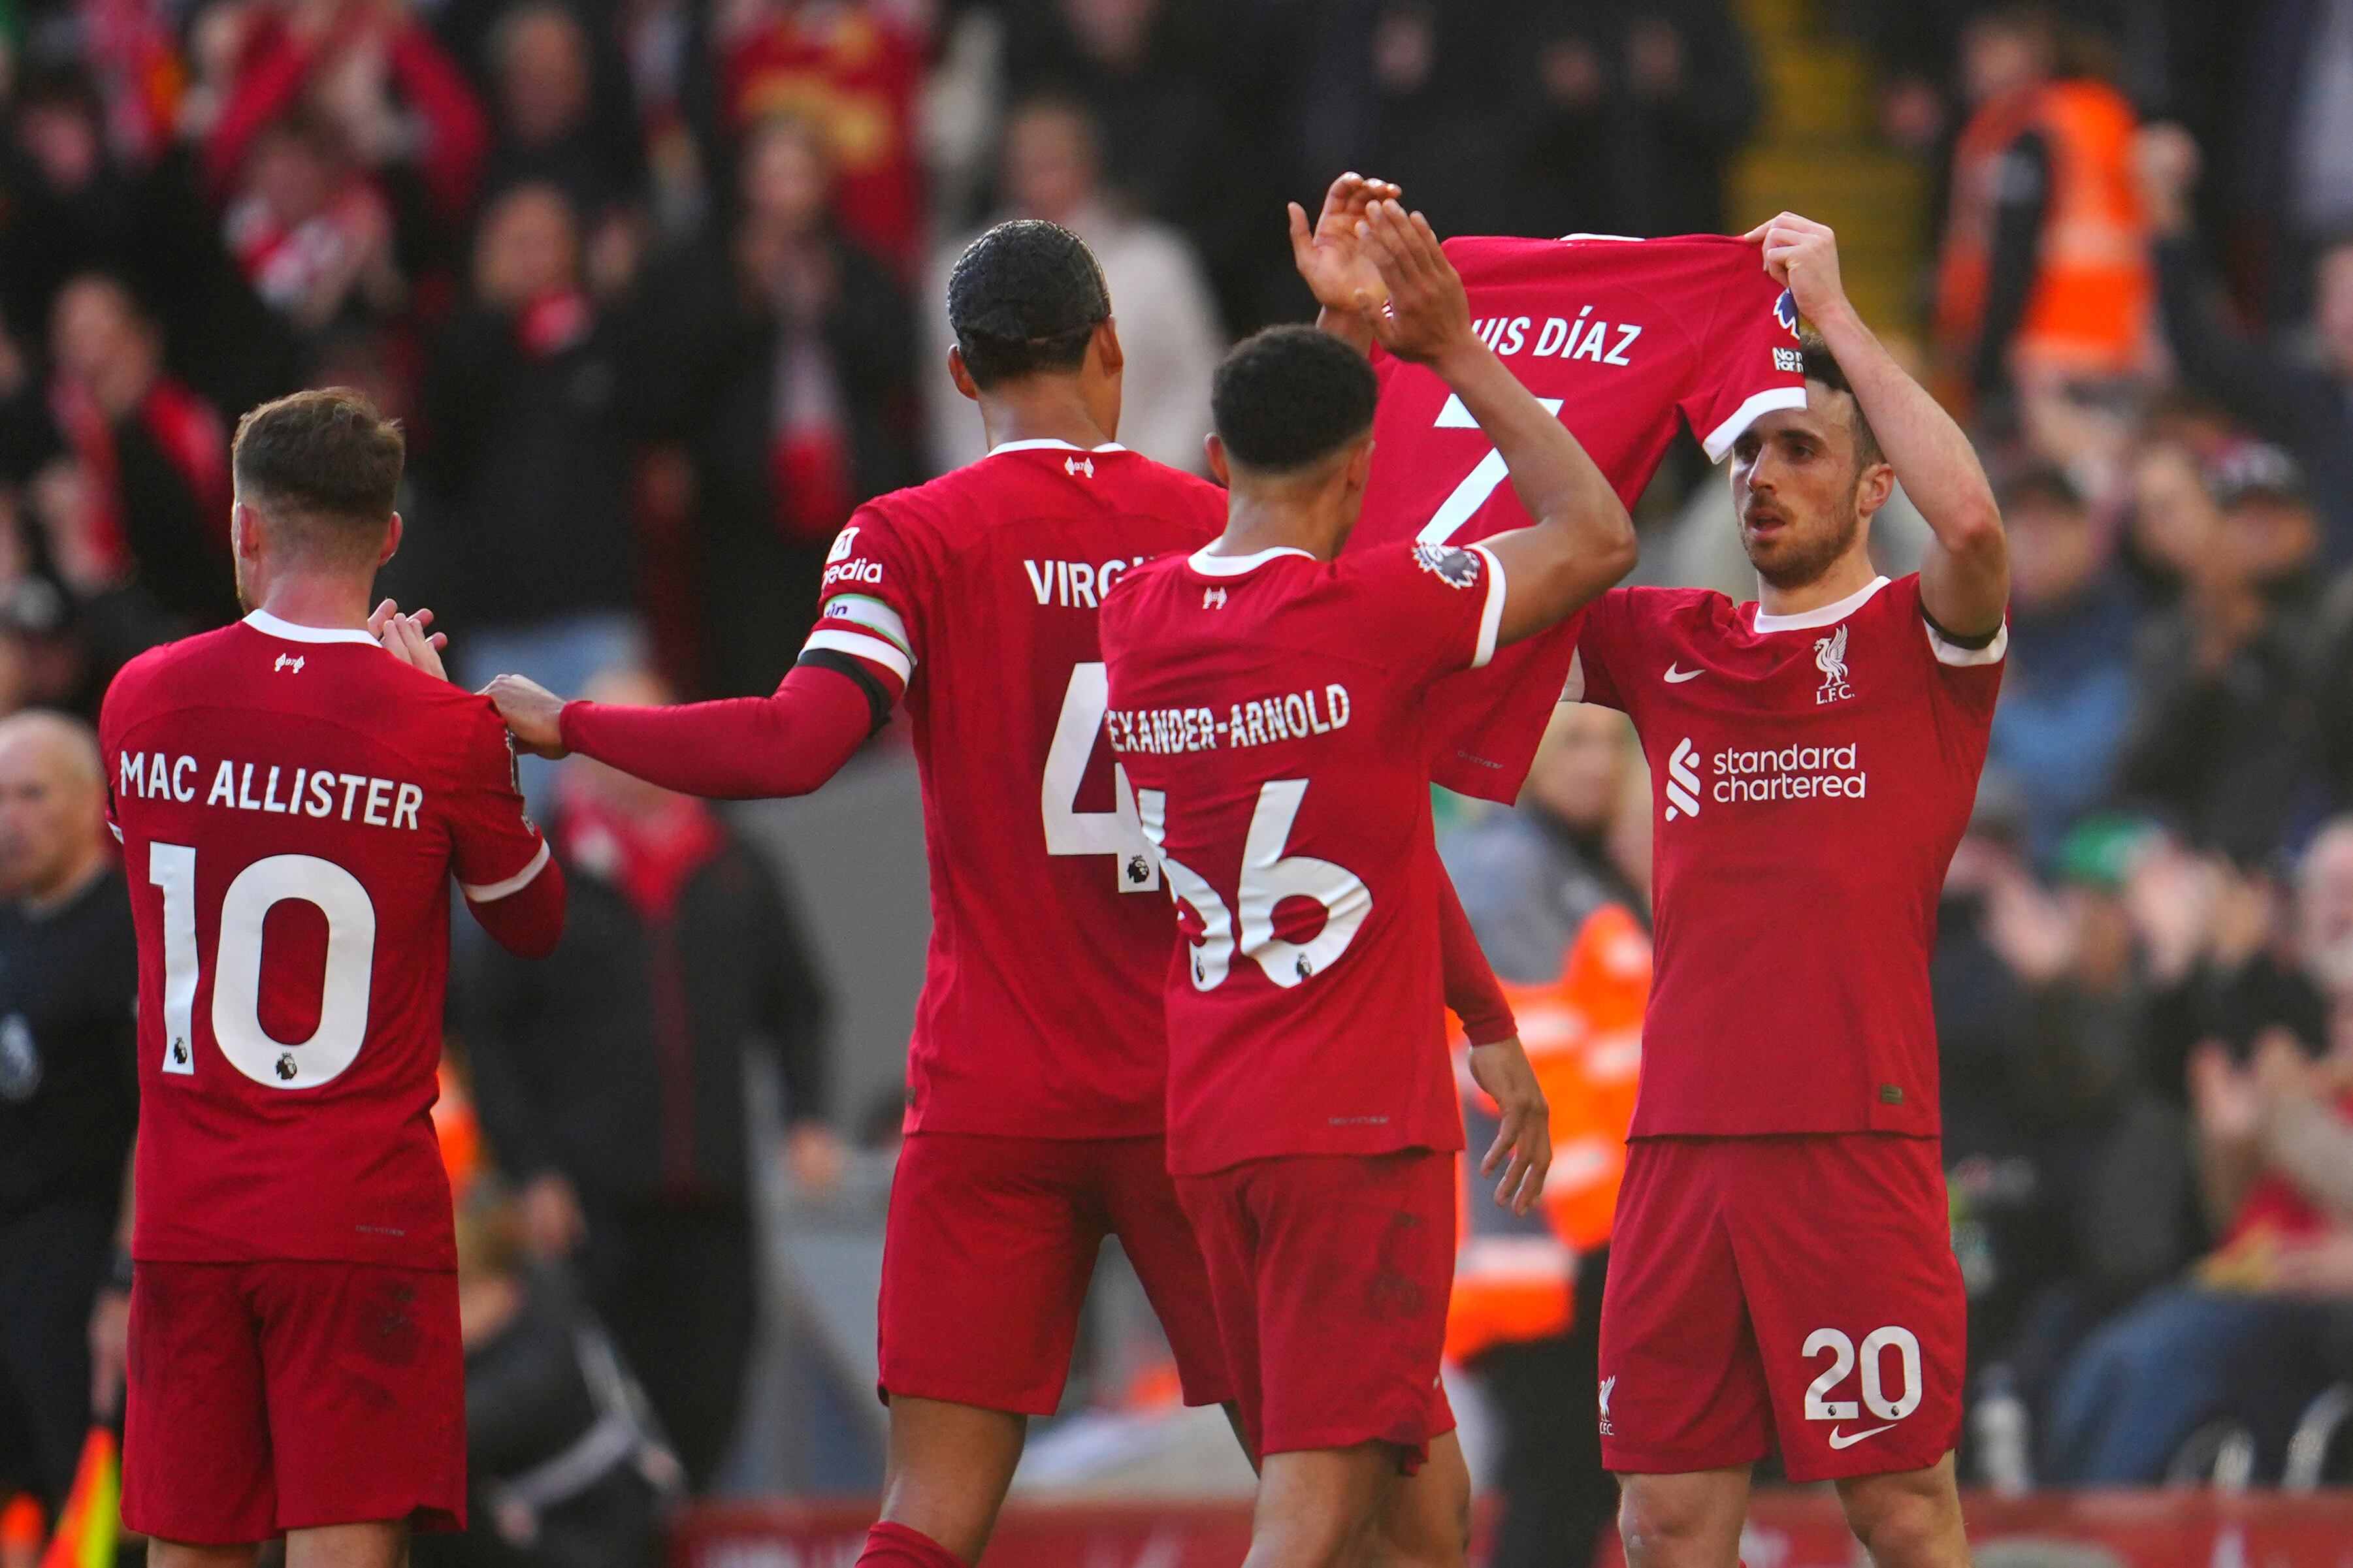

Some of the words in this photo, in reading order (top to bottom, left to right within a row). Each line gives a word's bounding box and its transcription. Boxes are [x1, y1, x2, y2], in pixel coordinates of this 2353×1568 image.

[1471, 317, 1531, 355] UIS
[1533, 305, 1642, 366] DÍAZ
[1024, 556, 1155, 609] VIRG
[120, 750, 197, 803] MAC
[207, 760, 423, 830] ALLISTER
[1041, 661, 1161, 893] 4
[1713, 743, 1857, 775] standard
[1713, 772, 1866, 803] chartered
[149, 841, 376, 1090] 10
[1802, 1325, 1923, 1420] 20
